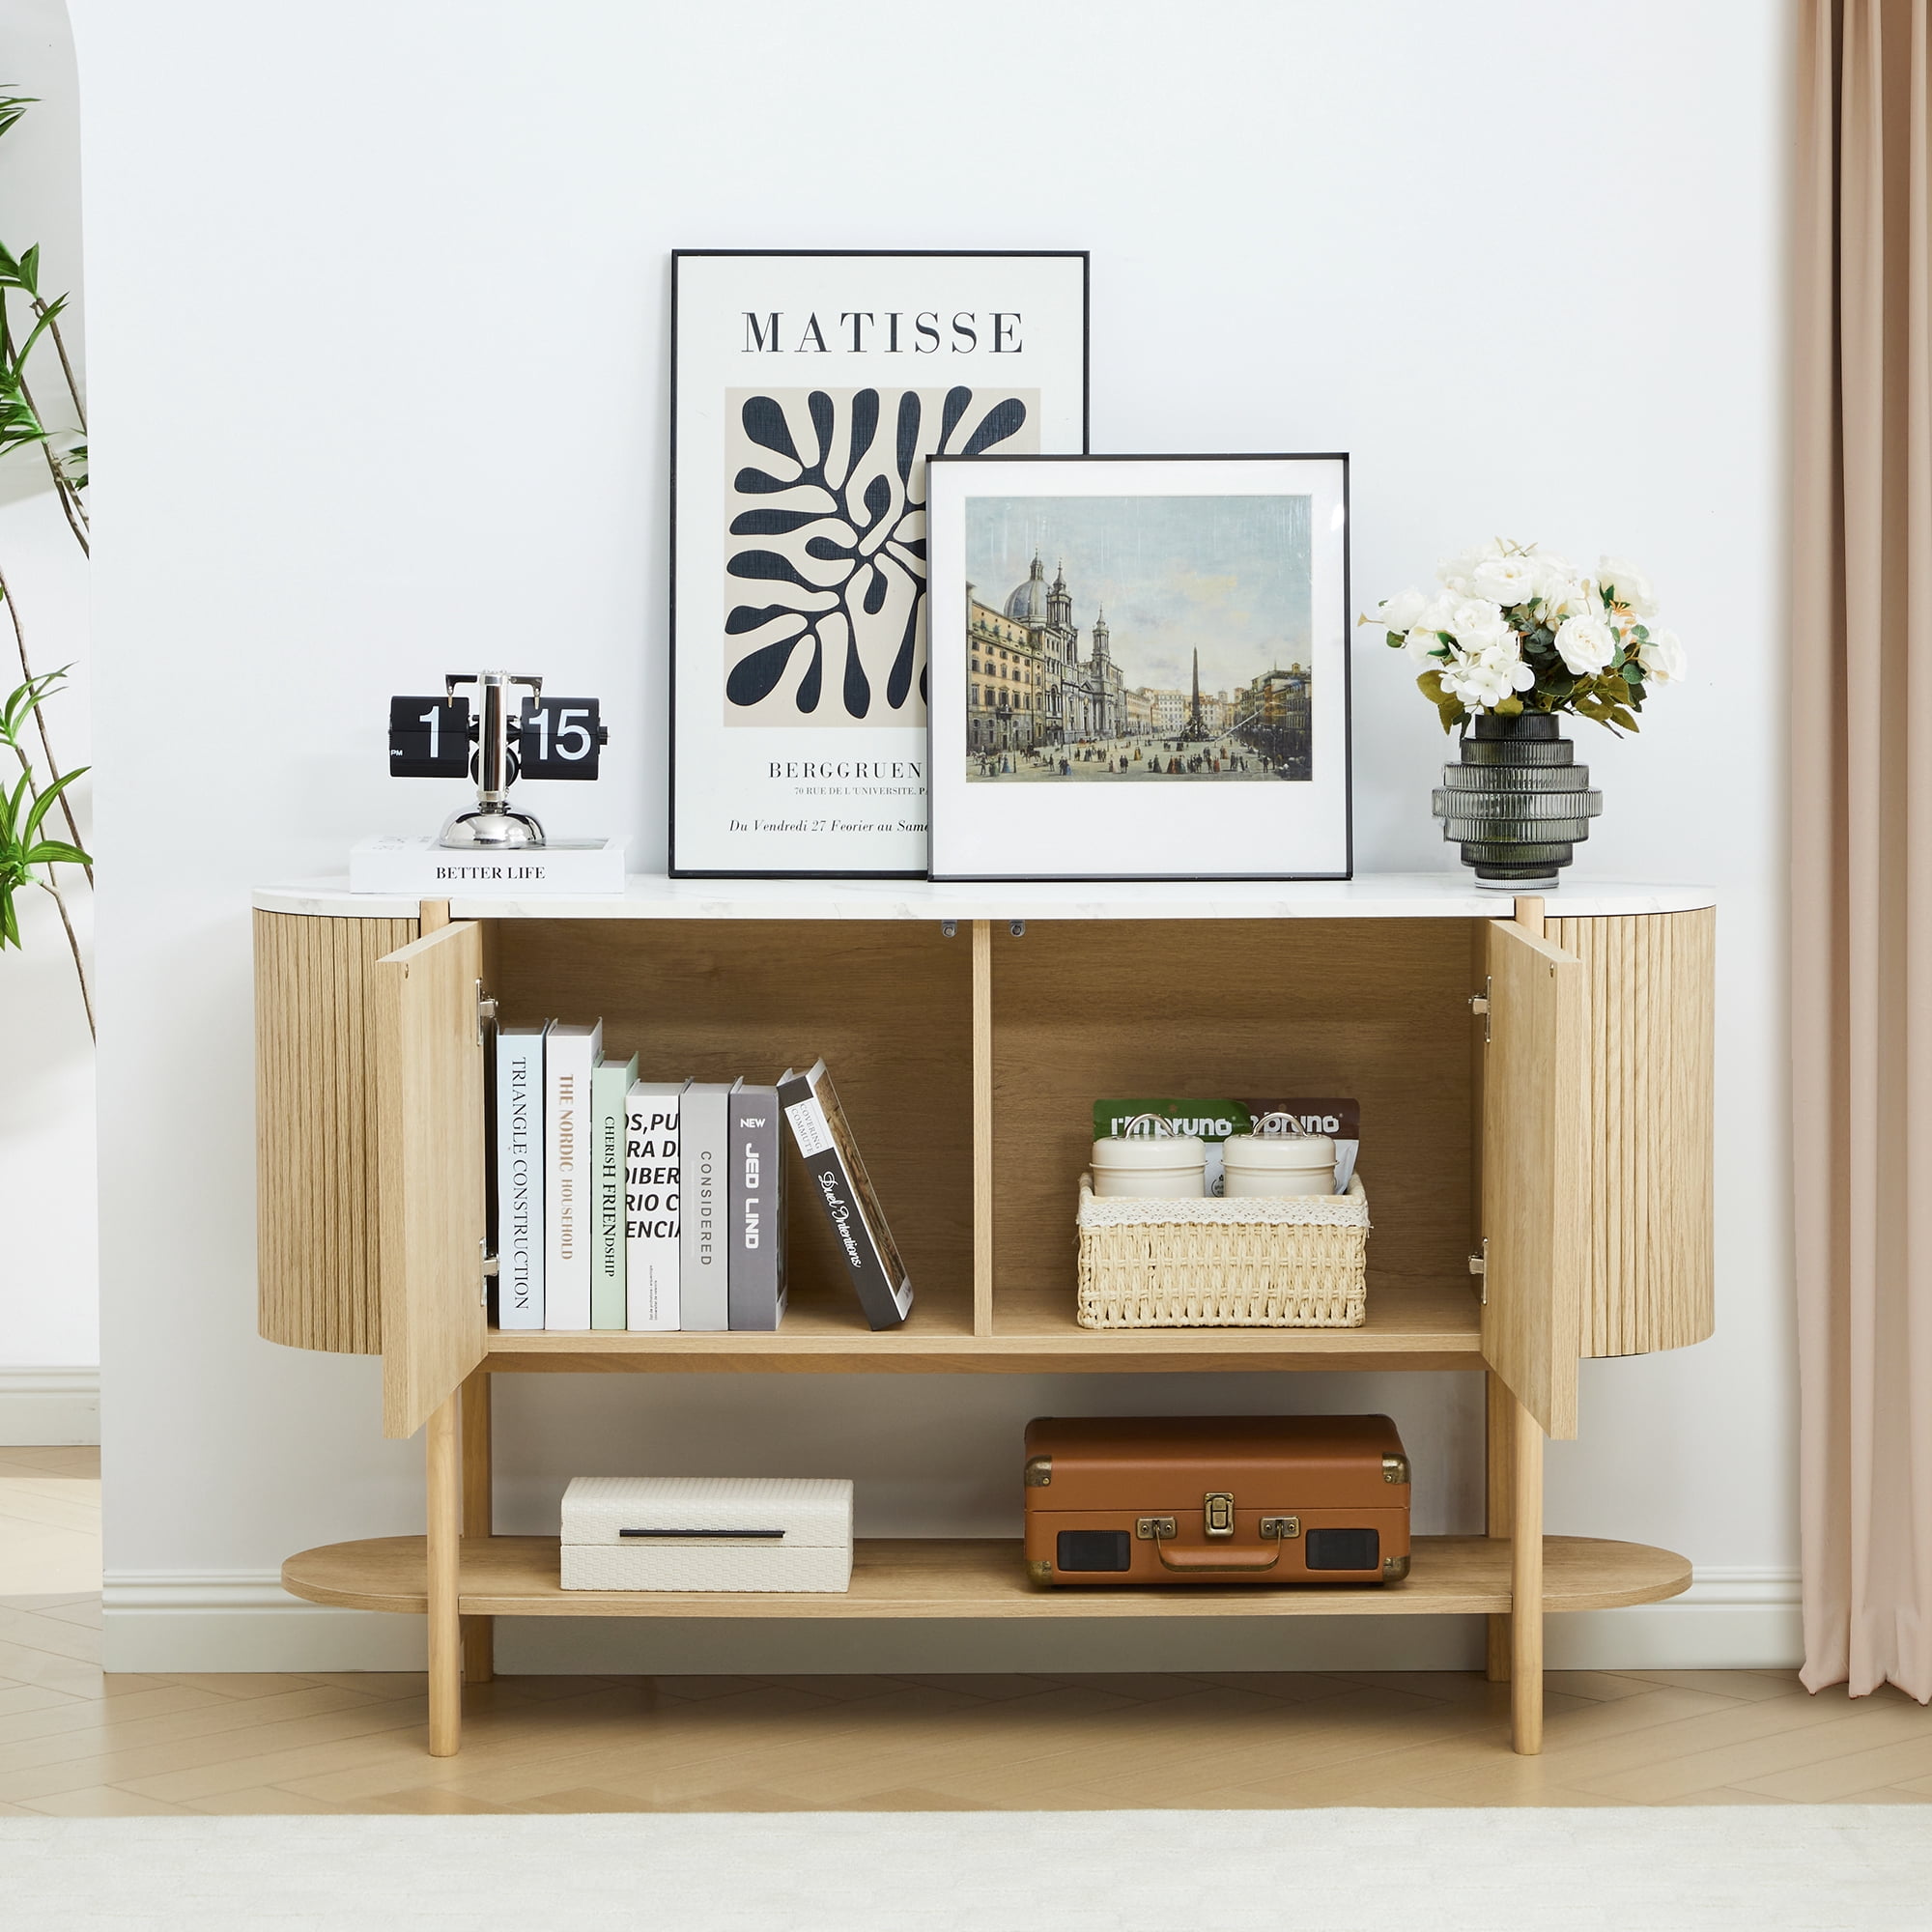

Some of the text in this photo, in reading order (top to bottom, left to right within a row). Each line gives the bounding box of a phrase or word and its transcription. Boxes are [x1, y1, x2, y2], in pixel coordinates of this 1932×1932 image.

[741, 311, 1024, 354] MATISSE
[419, 705, 440, 758] 1
[528, 707, 591, 761] 15
[768, 761, 923, 779] BERGGRUEN
[729, 819, 748, 832] Du
[753, 819, 808, 832] Vendredi
[811, 819, 827, 832] 27
[831, 819, 874, 832] Feorier
[877, 822, 893, 832] au
[436, 867, 546, 880] BETTER LIFE
[740, 1117, 766, 1129] NEW
[791, 1108, 814, 1153] COMMUTE
[800, 1103, 823, 1150] COVERING
[511, 1057, 529, 1310] TRIANGLE CONSTRUCTION
[558, 1073, 574, 1261] THE NORDIC HOUSEHOLD
[602, 1116, 616, 1278] CHERISH FRIENDSHIP
[700, 1151, 712, 1266] CONSIDERED
[745, 1143, 760, 1250] JED LIND
[817, 1171, 862, 1268] Duel Intentions
